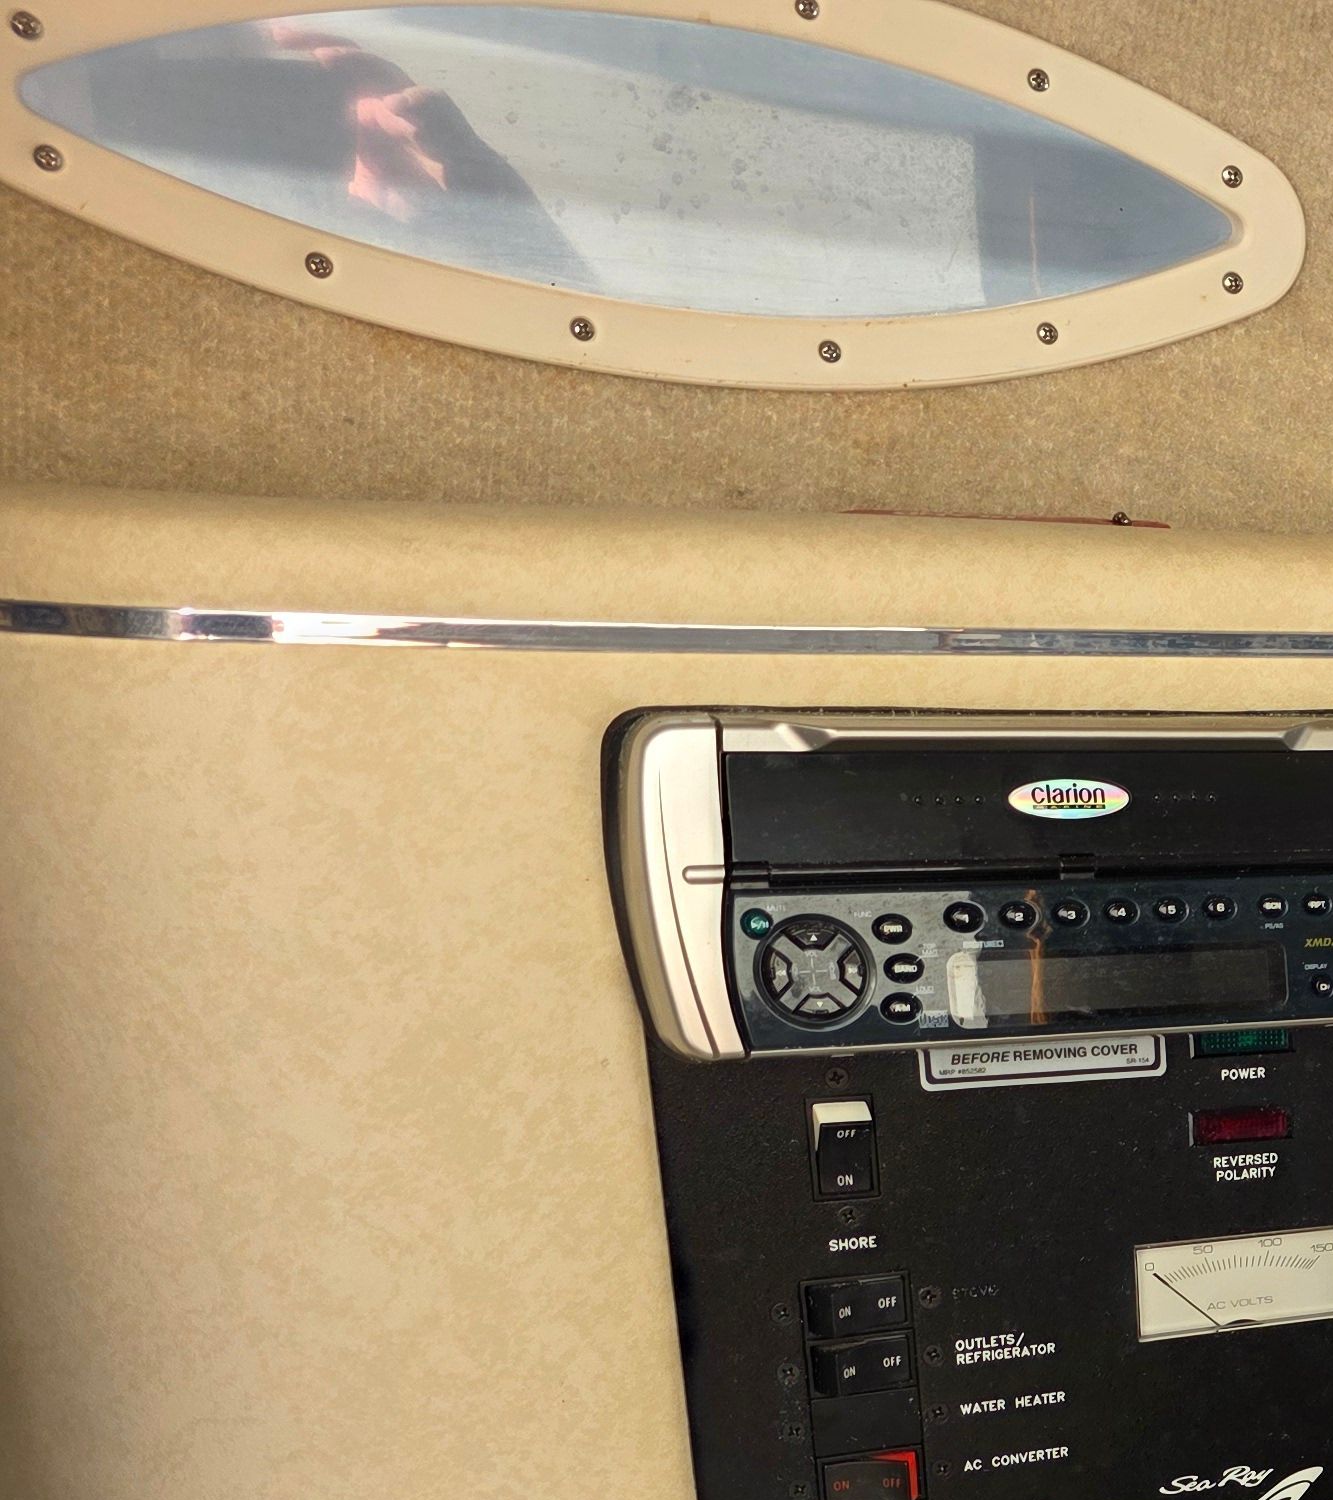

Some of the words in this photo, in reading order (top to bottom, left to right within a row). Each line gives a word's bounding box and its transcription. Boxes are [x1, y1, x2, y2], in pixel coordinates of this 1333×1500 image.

[1031, 783, 1106, 804] Clarion
[1117, 907, 1126, 917] 4
[1168, 905, 1176, 915] 5
[1216, 903, 1225, 912] 6
[1015, 912, 1024, 922] 2
[1067, 910, 1076, 920] 3
[951, 1050, 1009, 1066] BEFORE
[1013, 1047, 1087, 1062] REMOVING
[1091, 1043, 1138, 1057] COVER
[1220, 1066, 1266, 1081] POWER
[836, 1129, 857, 1139] OFF
[1213, 1152, 1279, 1168] REVERSED
[1216, 1166, 1277, 1181] POLARITY
[837, 1174, 854, 1187] ON
[828, 1235, 878, 1252] SHORE
[1257, 1238, 1283, 1248] 100
[1310, 1242, 1333, 1253] 150
[1192, 1245, 1214, 1255] 50
[1144, 1262, 1155, 1272] 0
[878, 1296, 897, 1309] OFF
[1206, 1301, 1226, 1311] AC
[1230, 1295, 1274, 1307] VOLTS
[838, 1306, 851, 1319] ON
[955, 1332, 1025, 1352] OUTLETS/
[956, 1342, 1056, 1366] REFRIGERATOR
[883, 1355, 902, 1368] OFF
[843, 1366, 856, 1379] ON
[960, 1398, 1006, 1416] WATER
[1015, 1391, 1066, 1409] HEATER
[963, 1459, 983, 1472] AC
[991, 1446, 1069, 1468] CONVERTER
[833, 1480, 850, 1491] ON
[882, 1477, 901, 1488] OFF
[1158, 1475, 1217, 1495] Sea
[1218, 1465, 1274, 1488] Ray
